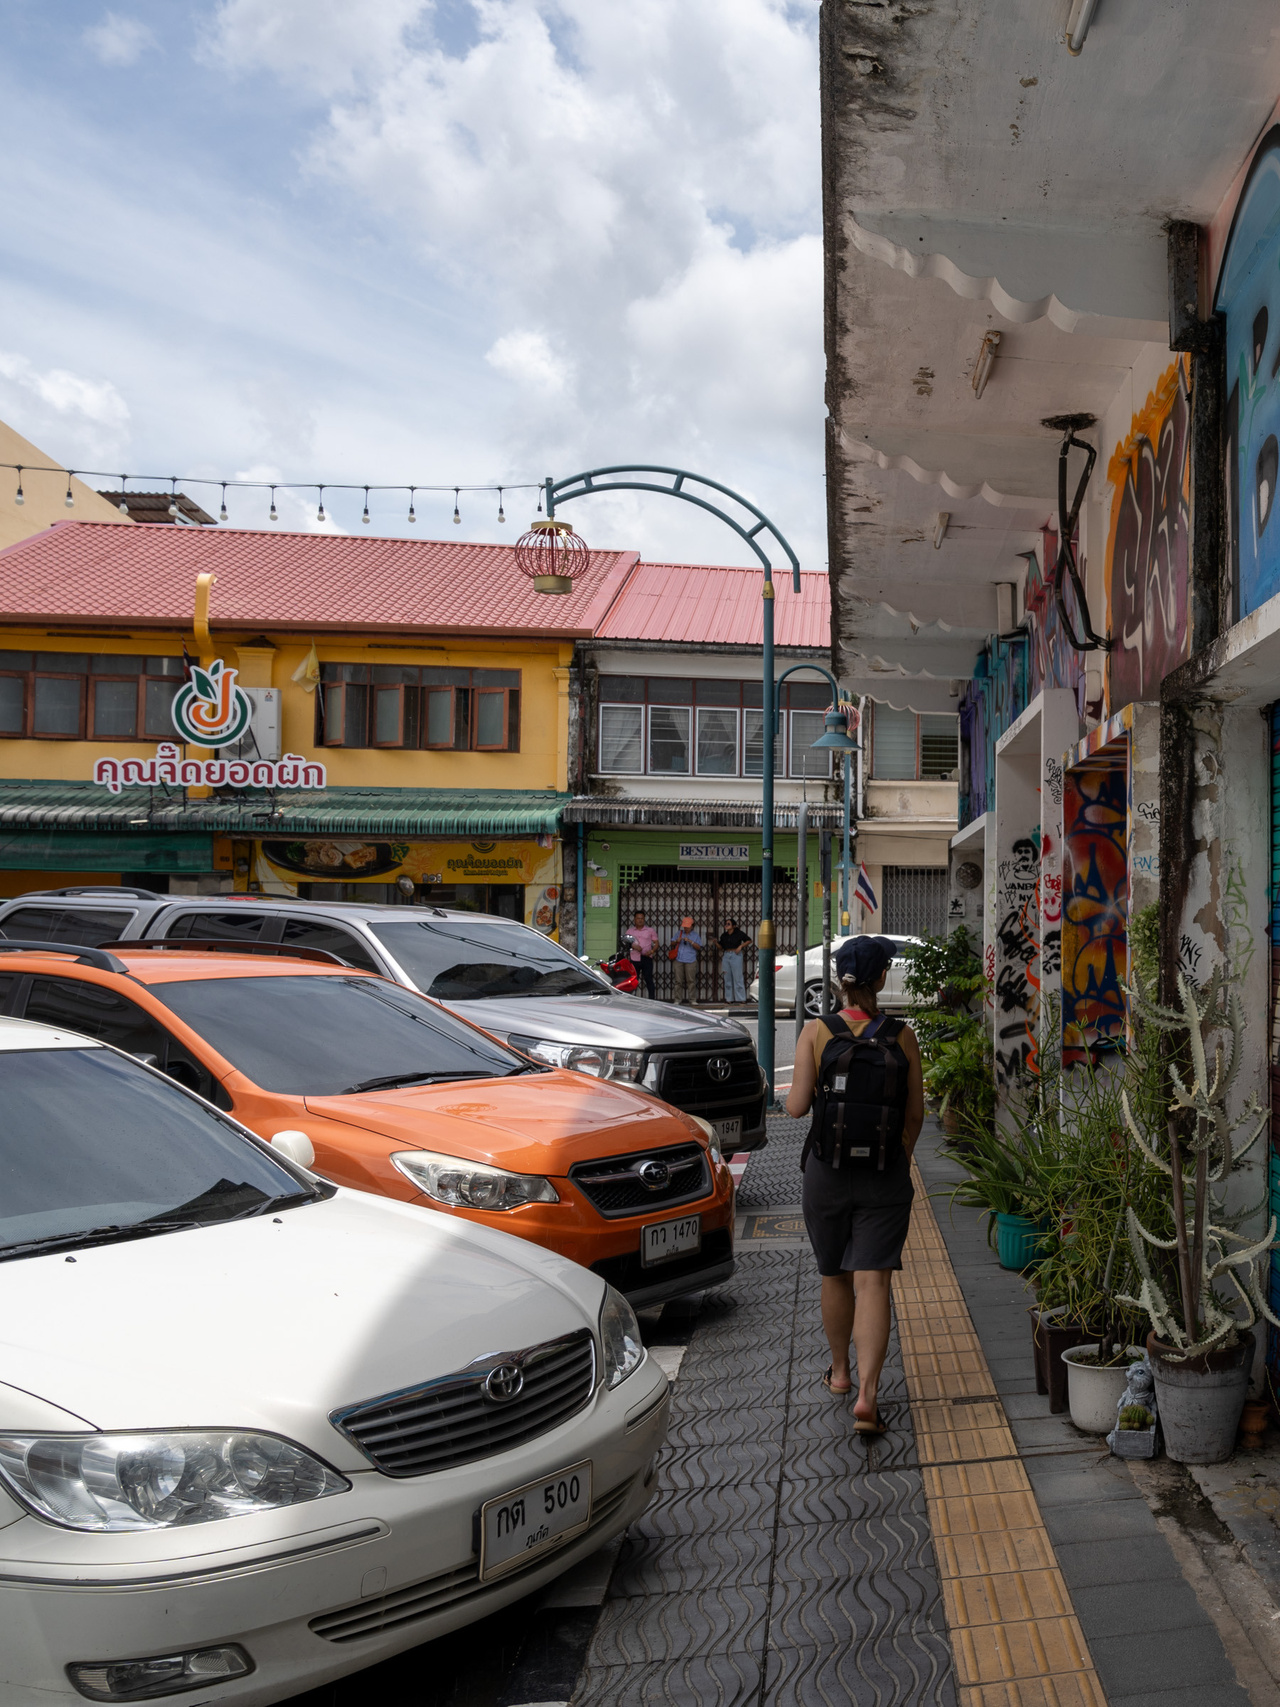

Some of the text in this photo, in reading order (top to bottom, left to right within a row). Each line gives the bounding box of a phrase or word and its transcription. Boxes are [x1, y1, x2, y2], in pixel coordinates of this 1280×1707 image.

[95, 744, 324, 793] คุณจี๊ดยอดผัก
[681, 846, 748, 857] BEST TOUR
[722, 1121, 739, 1134] 1947
[651, 1220, 697, 1246] กว 1470
[544, 1475, 580, 1514] 500
